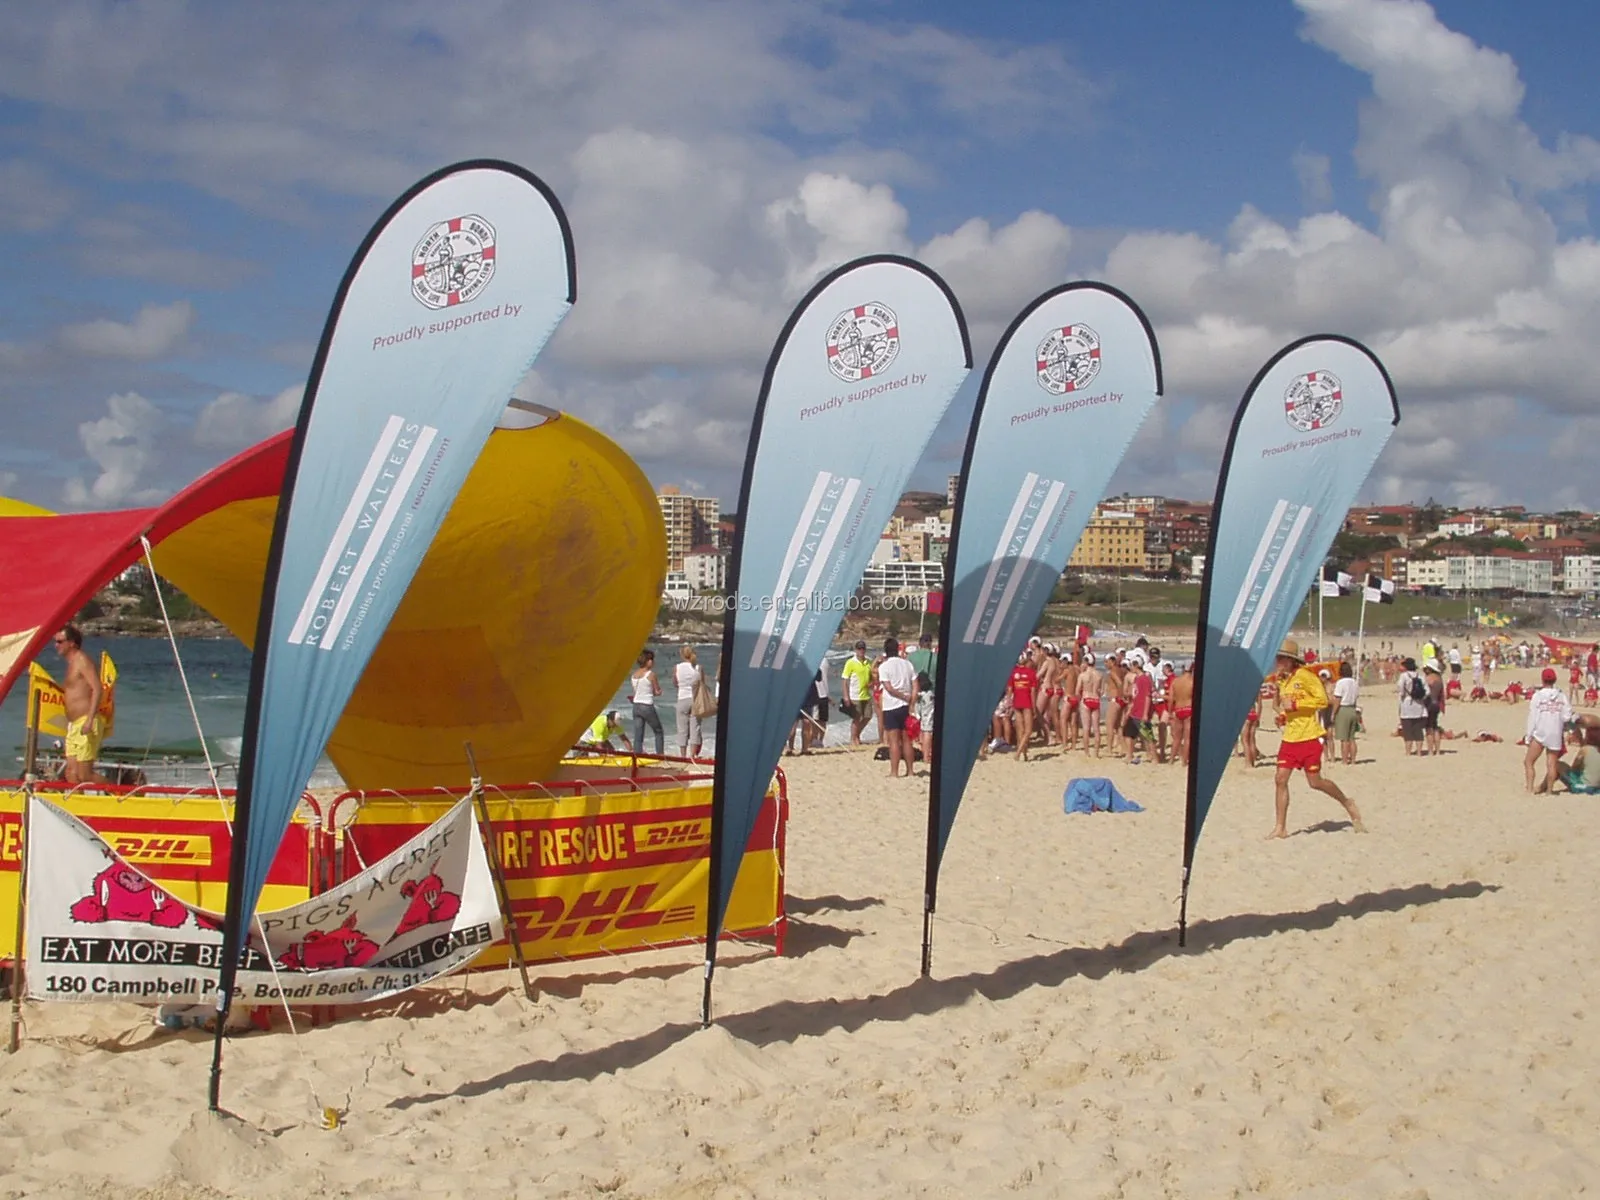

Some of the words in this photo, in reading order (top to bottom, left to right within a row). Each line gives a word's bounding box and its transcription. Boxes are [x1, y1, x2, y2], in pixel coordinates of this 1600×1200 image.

[419, 231, 440, 257] NORTH
[372, 325, 425, 350] Proudly
[428, 304, 500, 334] supported
[504, 303, 522, 317] by
[800, 395, 844, 421] Proudly
[847, 375, 908, 402] supported
[911, 373, 927, 385] by
[1010, 406, 1050, 426] Proudly
[1052, 393, 1107, 412] supported
[1109, 392, 1124, 404] by
[1262, 441, 1298, 458] Proudly
[1299, 429, 1348, 448] supported
[1350, 428, 1362, 437] by
[306, 548, 357, 646] ROBERT
[358, 423, 419, 530] WALTERS
[798, 476, 845, 569] WALTERS
[1006, 479, 1050, 557] WALTERS
[342, 591, 376, 651] specialist
[373, 512, 413, 591] professional
[411, 437, 451, 511] recruitment
[1231, 584, 1263, 647] ROBERT
[1261, 503, 1300, 573] WALTERS
[115, 837, 197, 859] DHL
[540, 823, 629, 867] RESCUE
[647, 823, 706, 846] DHL
[263, 895, 353, 933] PIGS
[505, 883, 666, 944] DHL
[43, 938, 98, 962] EAT
[107, 941, 187, 964] MORE
[431, 922, 492, 959] CAFE
[46, 976, 86, 994] 180
[92, 976, 197, 997] Campbell
[254, 983, 314, 999] Bondi
[315, 976, 368, 997] Beach.
[372, 974, 399, 990] Ph:
